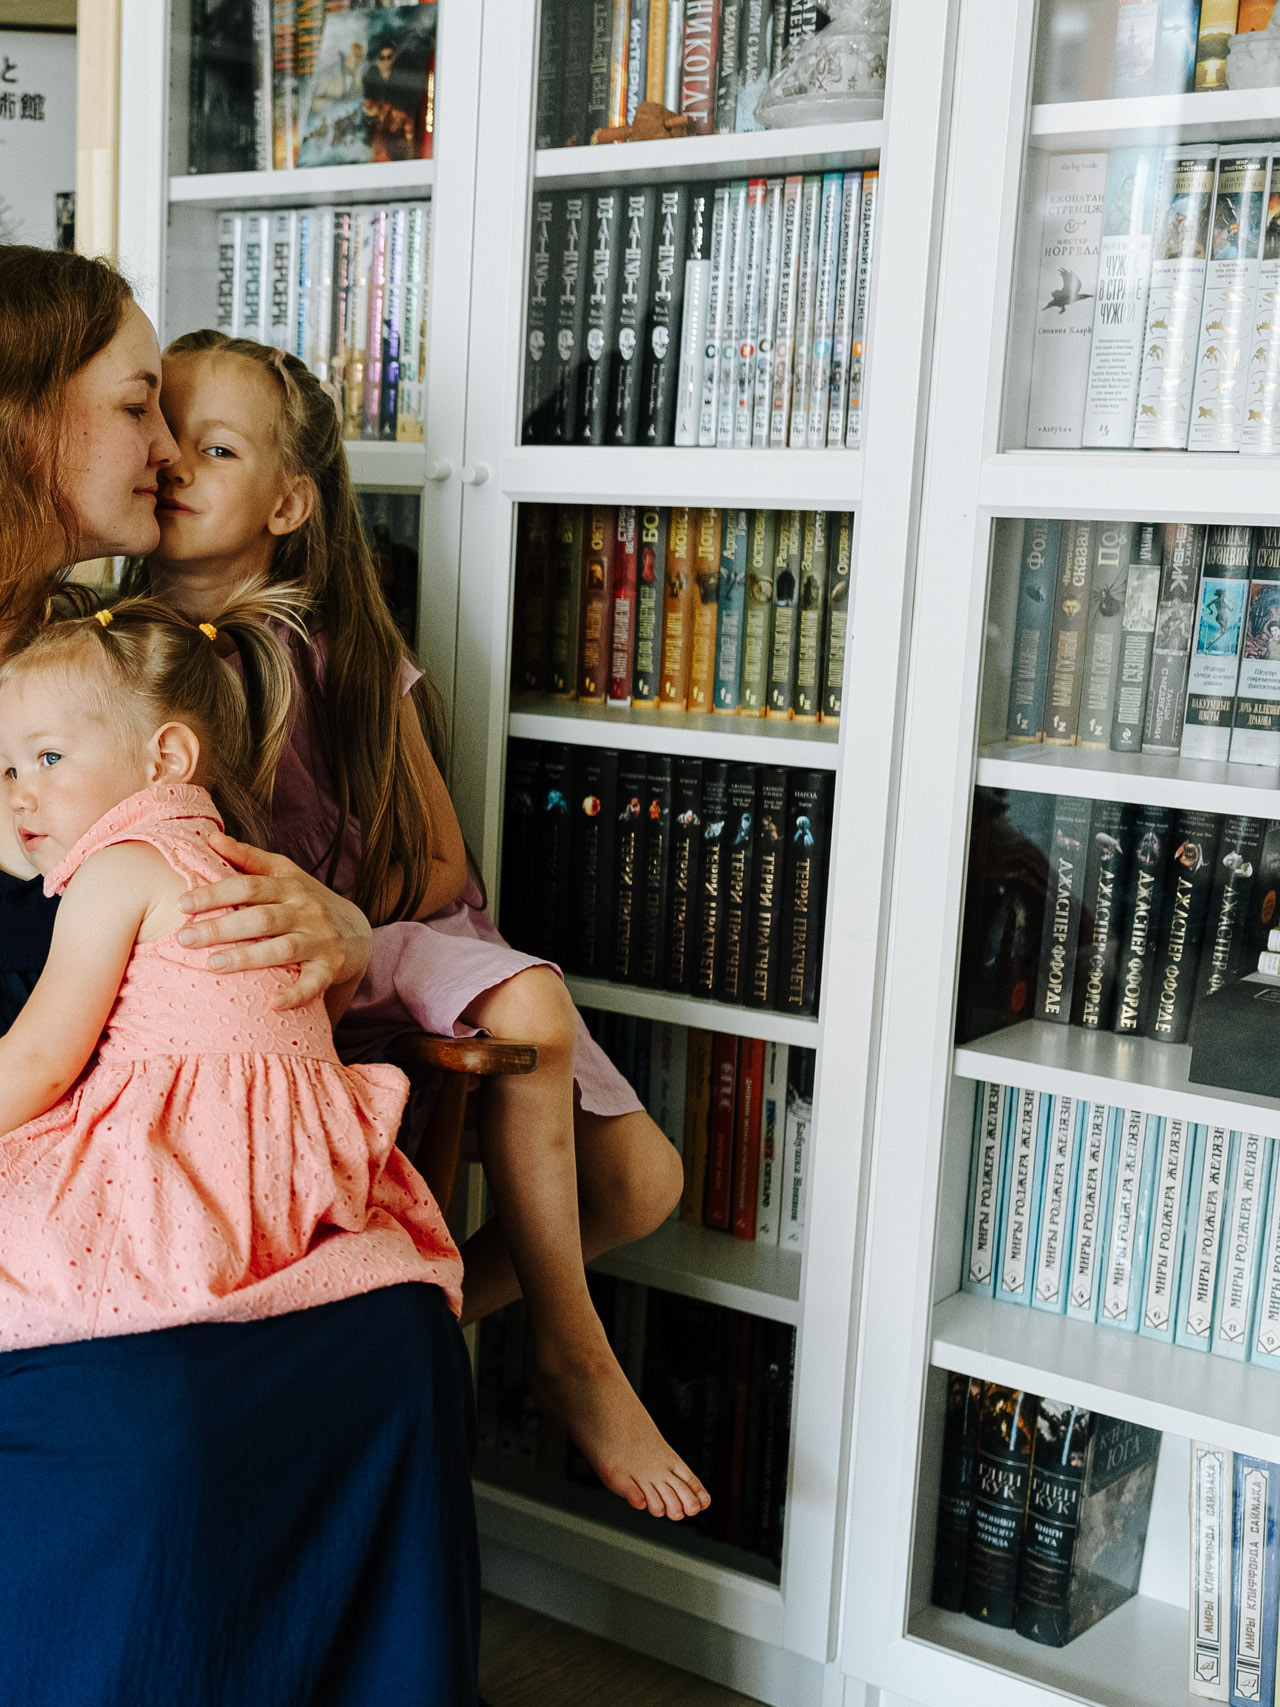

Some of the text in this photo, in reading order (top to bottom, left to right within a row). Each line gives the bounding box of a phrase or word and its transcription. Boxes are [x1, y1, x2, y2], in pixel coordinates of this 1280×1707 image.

[627, 18, 642, 126] ИНТЕРМИ
[682, 0, 713, 124] НИКОГДЕ
[721, 6, 737, 77] КОРАЛИНА
[1048, 203, 1104, 215] СТРЕНДЖ
[219, 243, 236, 328] БЕРСЕРК
[244, 242, 262, 328] БЕРСЕРК
[272, 242, 290, 328] БЕРСЕРК
[1106, 254, 1140, 276] ЧУЖК
[642, 512, 659, 543] БО
[1169, 524, 1190, 592] ЭНВИК
[1206, 546, 1251, 567] СУЭНВИК
[1211, 526, 1251, 547] МАЙКЛ
[1117, 634, 1147, 725] МАЙКЛ СУЭНВИК
[730, 850, 746, 904] ТЕРРИ
[753, 852, 775, 1001] ТЕРРИ ПРАТЧЕТТ
[788, 858, 811, 1006] ТЕРРИ ПРАТЧЕТТ
[1121, 957, 1145, 1030] ФФОРДЕ
[1155, 964, 1181, 1034] ФФОРДЕ
[980, 1144, 997, 1209] РОДЖЕРА
[1013, 1153, 1030, 1218] РОДЖЕРА
[1048, 1161, 1066, 1227] РОДЖЕРА
[1081, 1167, 1099, 1232] РОДЖЕРА
[976, 1212, 991, 1253] МИРЫ
[1009, 1220, 1025, 1261] МИРЫ
[1117, 1176, 1135, 1243] РОДЖЕРА
[1158, 1185, 1176, 1252] РОДЖЕРА
[1201, 1190, 1219, 1258] РОДЖЕРА
[1234, 1196, 1253, 1264] РОДЖЕРА
[1043, 1228, 1060, 1270] МИРЫ
[1078, 1236, 1094, 1277] МИРЫ
[1111, 1244, 1129, 1287] МИРЫ
[1154, 1254, 1169, 1297] МИРЫ
[1196, 1260, 1211, 1304] МИРЫ
[1229, 1266, 1245, 1310] МИРЫ
[980, 1462, 1022, 1488] ГЛЕН
[1106, 1435, 1141, 1471] ЮГА
[981, 1478, 1015, 1499] КУК
[1033, 1477, 1077, 1504] ГЛЕН
[1035, 1492, 1070, 1515] КУК
[1204, 1524, 1217, 1595] КЛИФФОРДА
[1245, 1480, 1263, 1652] МИРЫ КЛИФФОРДА САЙМАКА
[1204, 1600, 1215, 1635] МИРЫ
